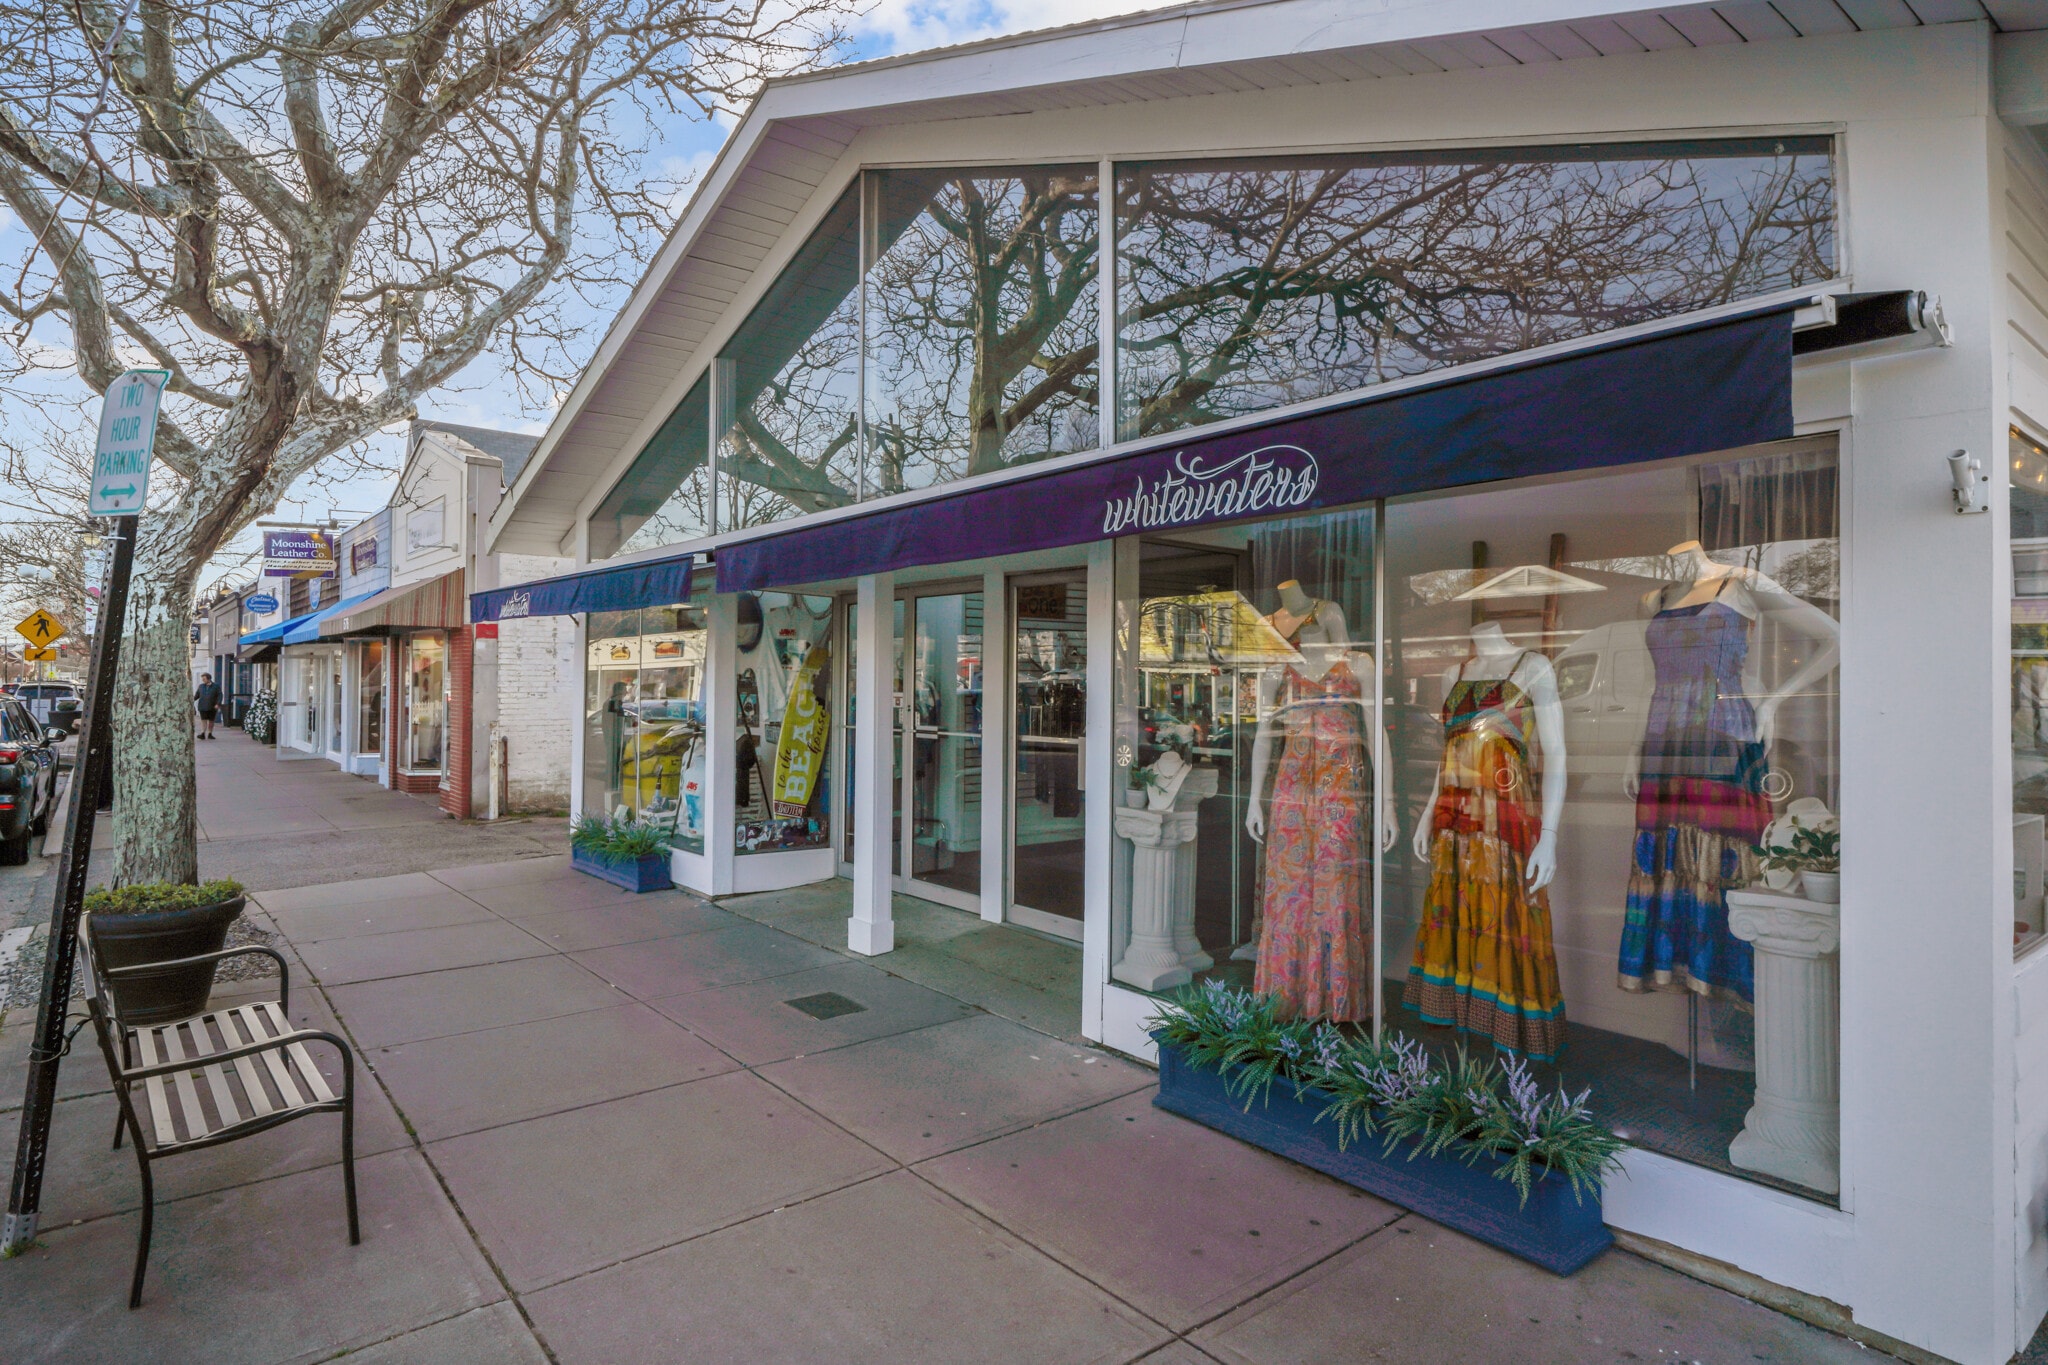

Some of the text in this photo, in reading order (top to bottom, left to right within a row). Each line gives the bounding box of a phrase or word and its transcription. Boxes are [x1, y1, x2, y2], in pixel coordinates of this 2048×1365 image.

[120, 383, 144, 408] TWO
[110, 416, 141, 443] HOUR
[98, 449, 146, 477] PARKING
[1103, 444, 1319, 534] whitewaters
[271, 538, 327, 549] Moonshine
[271, 548, 327, 559] Leather Co.
[806, 709, 827, 754] house
[779, 747, 792, 769] the
